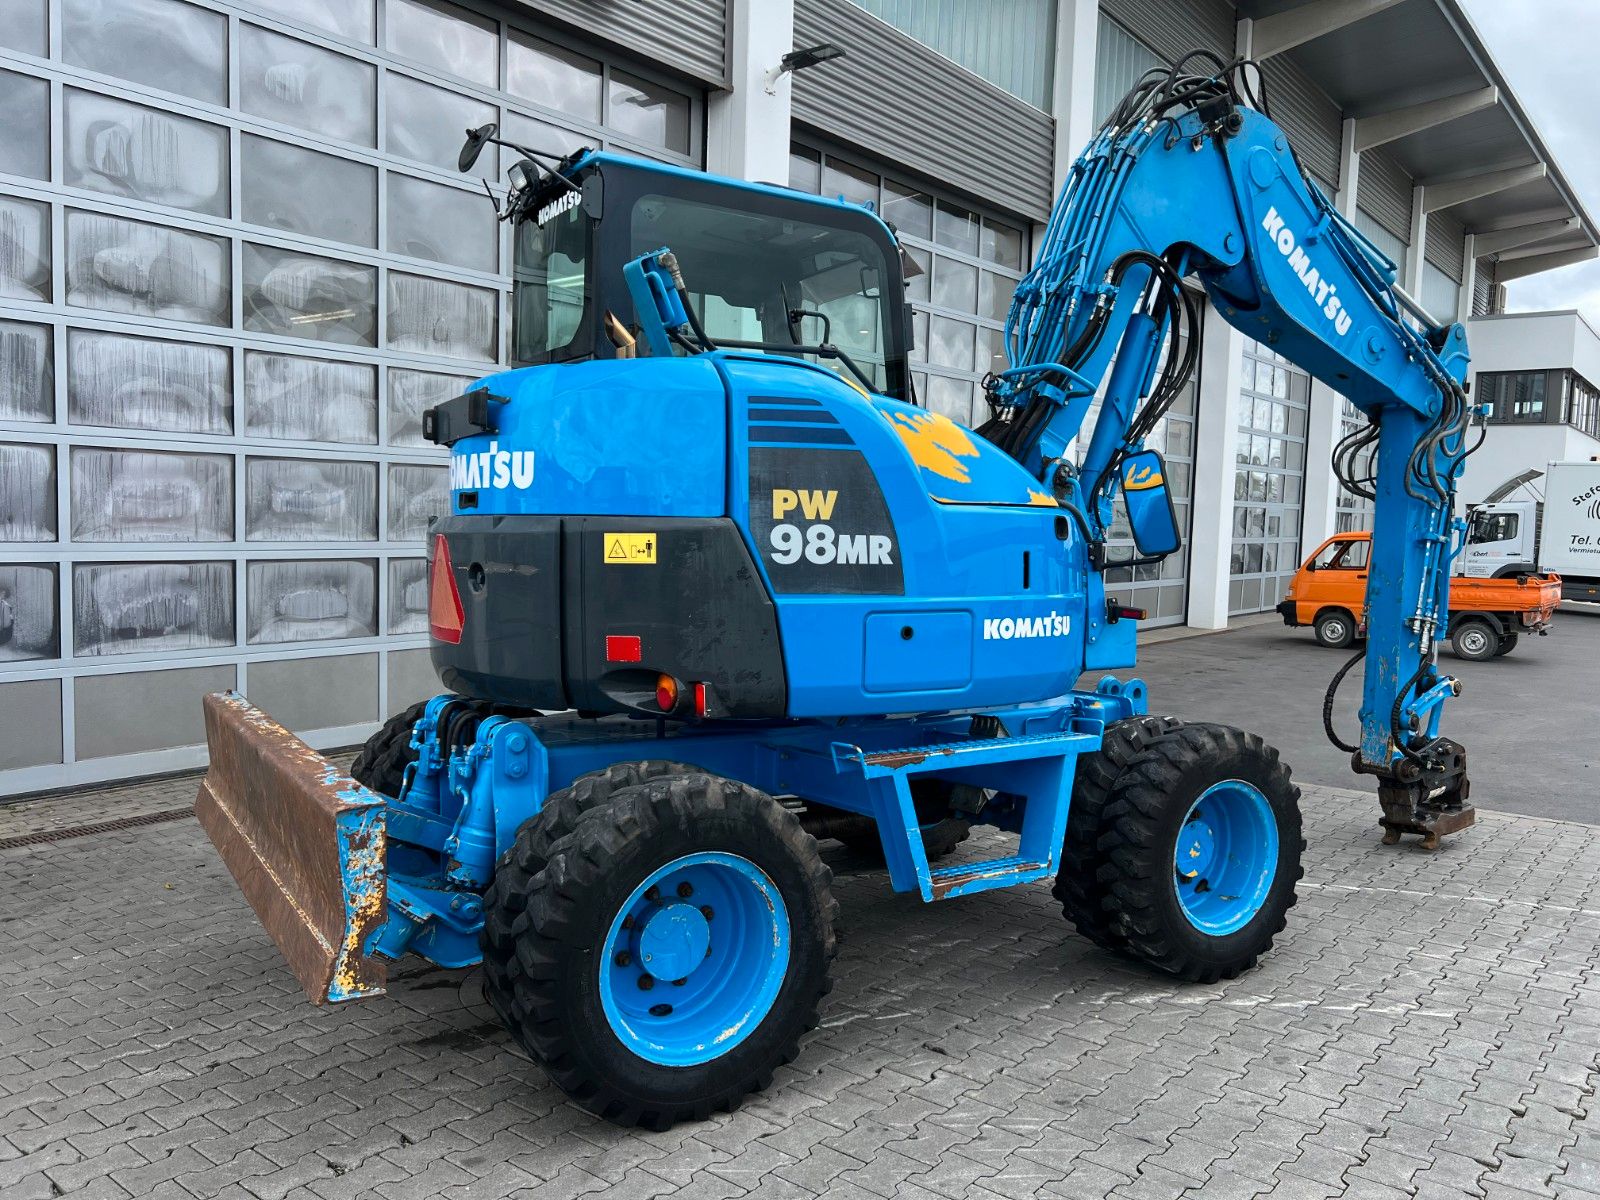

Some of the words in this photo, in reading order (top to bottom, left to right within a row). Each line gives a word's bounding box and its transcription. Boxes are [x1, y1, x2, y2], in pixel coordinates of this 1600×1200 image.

[538, 190, 582, 226] KOMATSU
[1262, 206, 1352, 336] KOMATSU
[449, 441, 534, 490] OMATSU
[772, 489, 839, 520] PW
[770, 524, 894, 565] 98MR
[1571, 535, 1592, 545] Tel.
[983, 611, 1071, 640] KOMATSU
